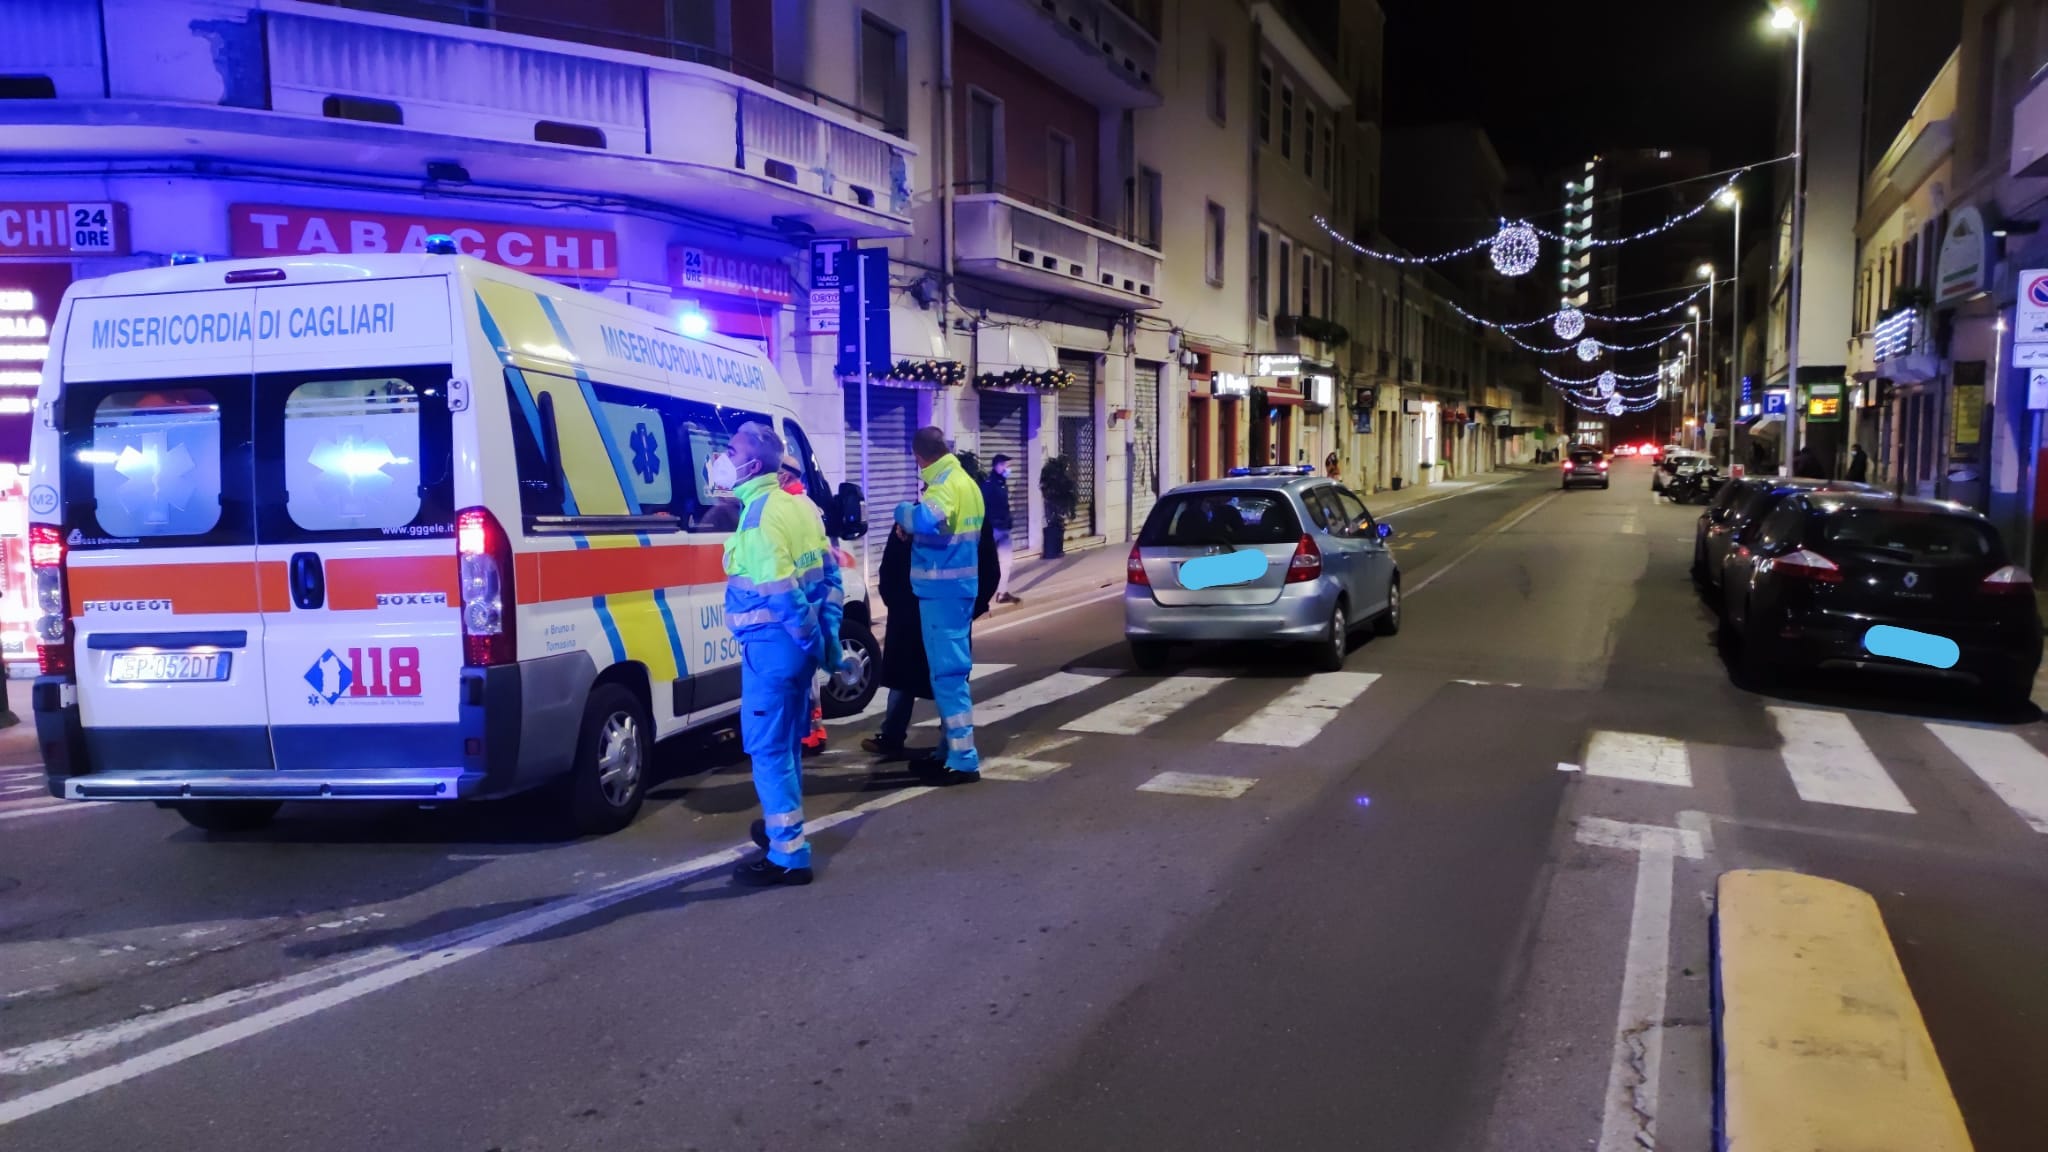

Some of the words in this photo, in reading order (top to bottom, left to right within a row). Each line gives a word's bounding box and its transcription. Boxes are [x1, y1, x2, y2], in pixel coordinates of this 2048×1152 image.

[75, 209, 107, 227] 24
[76, 231, 109, 246] ORE
[250, 213, 605, 271] TABACCHI
[686, 252, 700, 267] 24
[686, 269, 701, 282] ORE
[704, 255, 788, 297] TABACCHI
[92, 311, 252, 349] MISERICORDIA
[259, 309, 280, 339] DI
[289, 302, 394, 338] CAGLIARI
[600, 324, 703, 378] MISERICORDIA
[702, 353, 717, 380] DI
[717, 356, 767, 392] CAGLIARI
[1768, 396, 1781, 412] P
[33, 494, 53, 506] M2
[381, 523, 454, 536] www.gggele.it
[84, 600, 171, 612] PEUGEOT
[377, 594, 446, 606] BOXER
[700, 603, 726, 630] UNI
[704, 640, 716, 665] DI
[348, 646, 422, 696] 118
